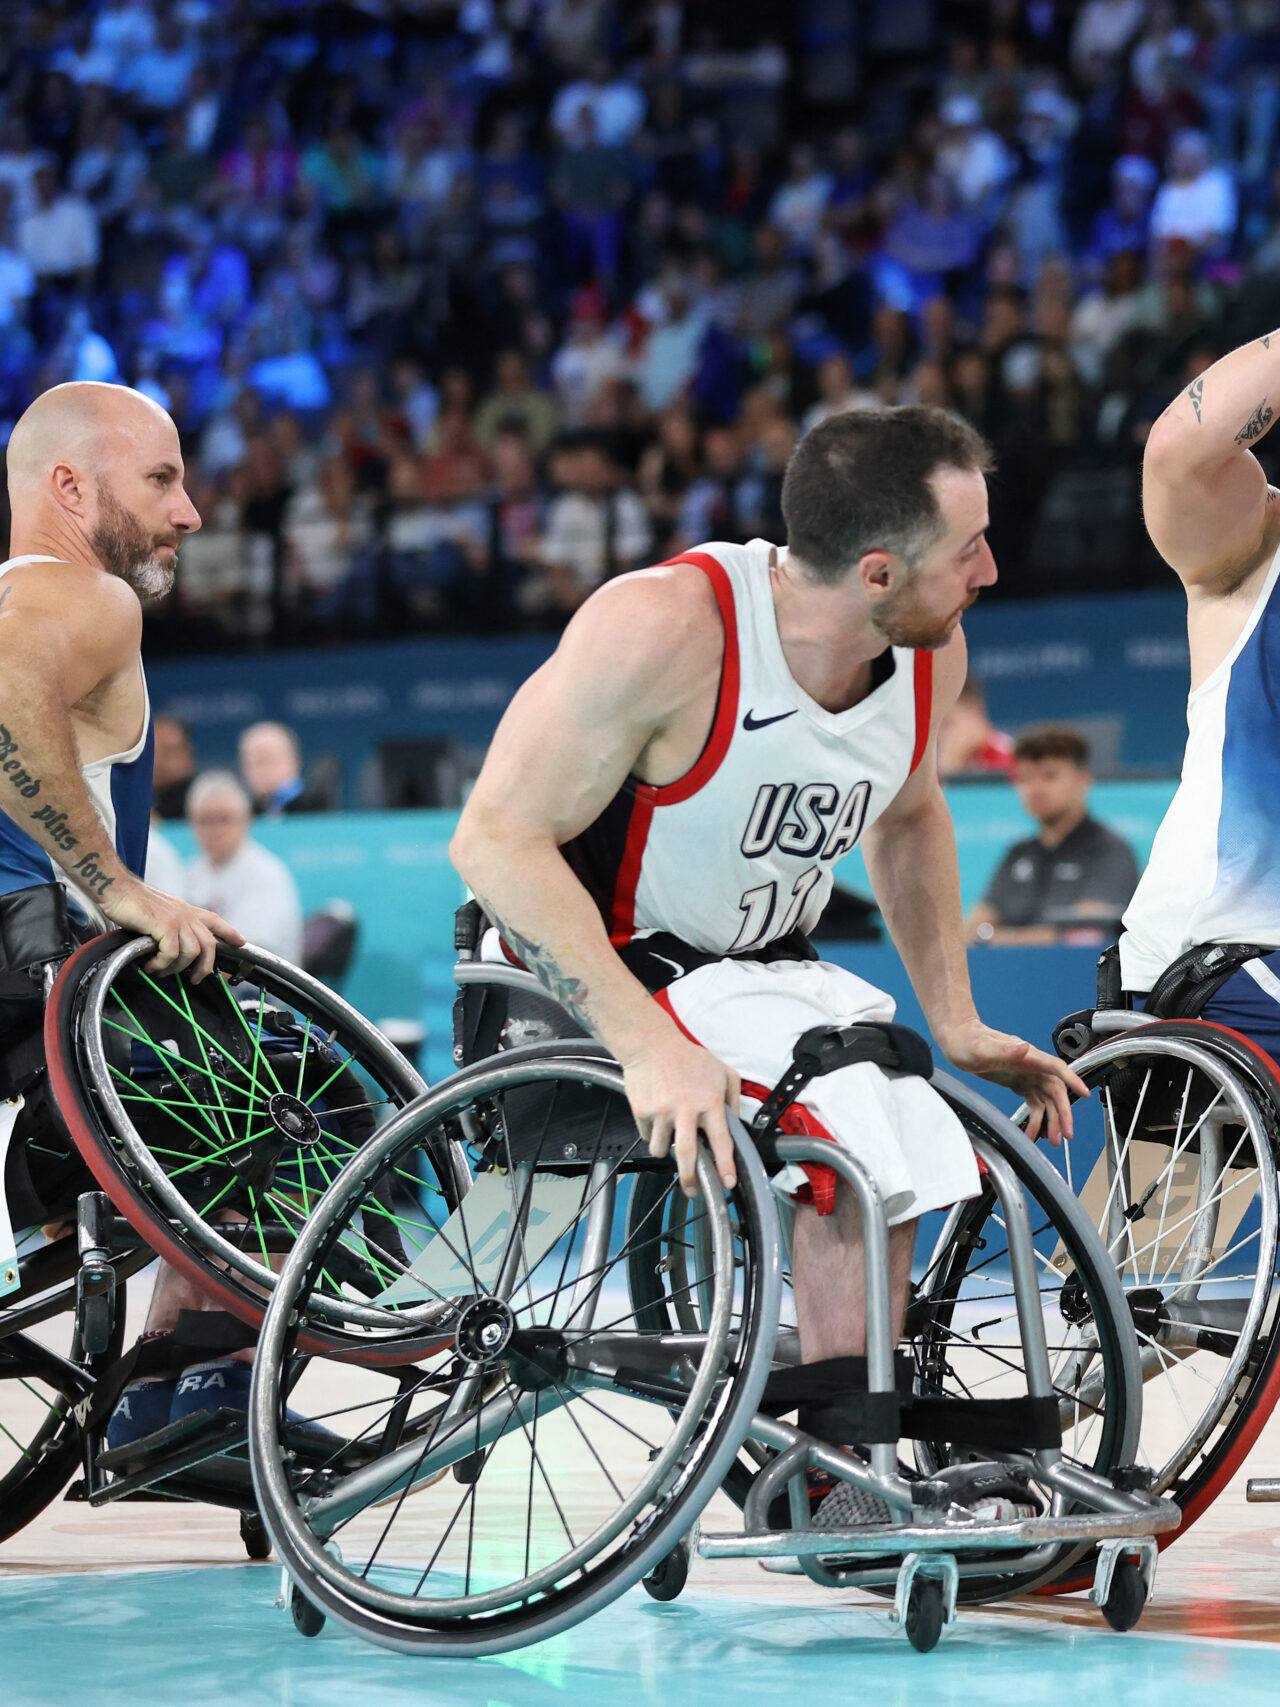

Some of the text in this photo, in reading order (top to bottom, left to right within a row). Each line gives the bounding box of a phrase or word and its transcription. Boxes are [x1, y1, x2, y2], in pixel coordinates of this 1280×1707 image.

[30, 805, 80, 851] plus
[72, 852, 115, 895] fort
[741, 780, 872, 860] USA
[728, 864, 822, 953] 11
